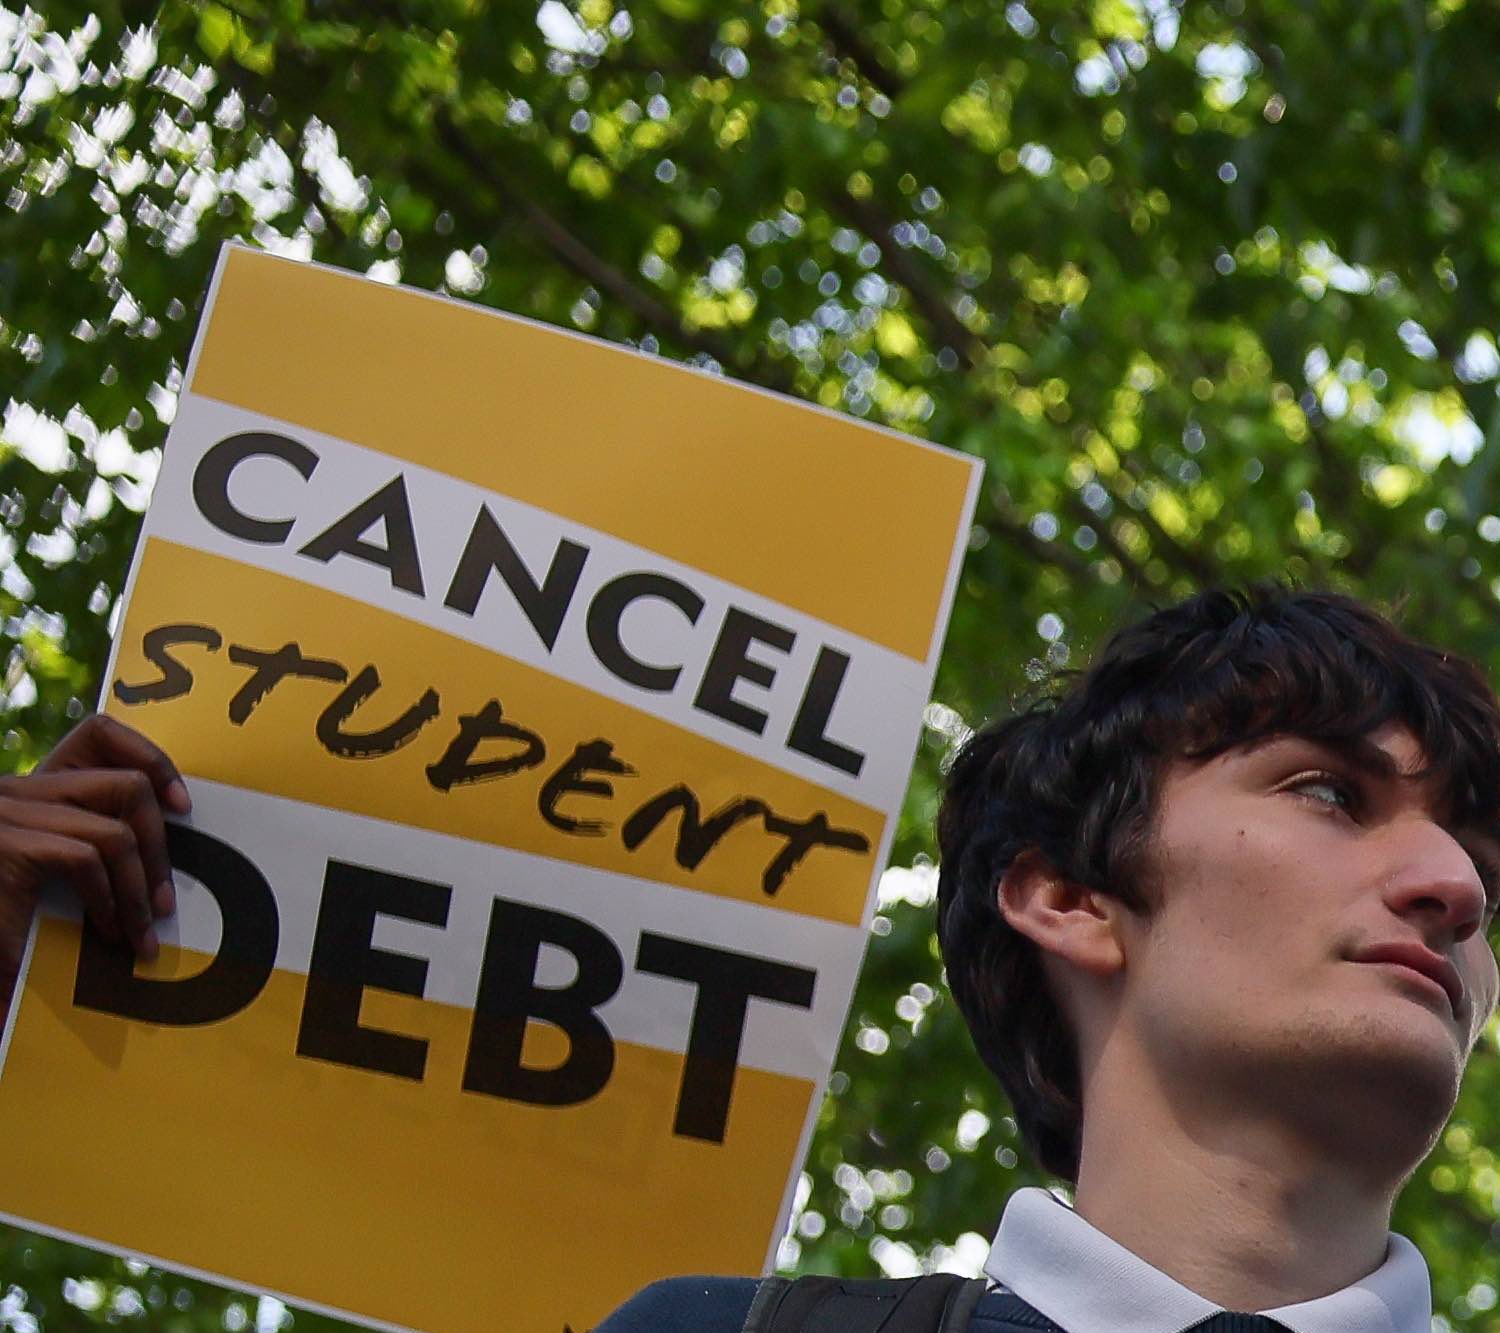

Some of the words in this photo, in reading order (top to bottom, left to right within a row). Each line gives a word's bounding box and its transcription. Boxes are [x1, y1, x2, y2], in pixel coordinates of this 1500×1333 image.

[113, 623, 872, 897] STUDENT
[191, 430, 866, 778] CANCEL
[72, 818, 819, 1146] DEBT
